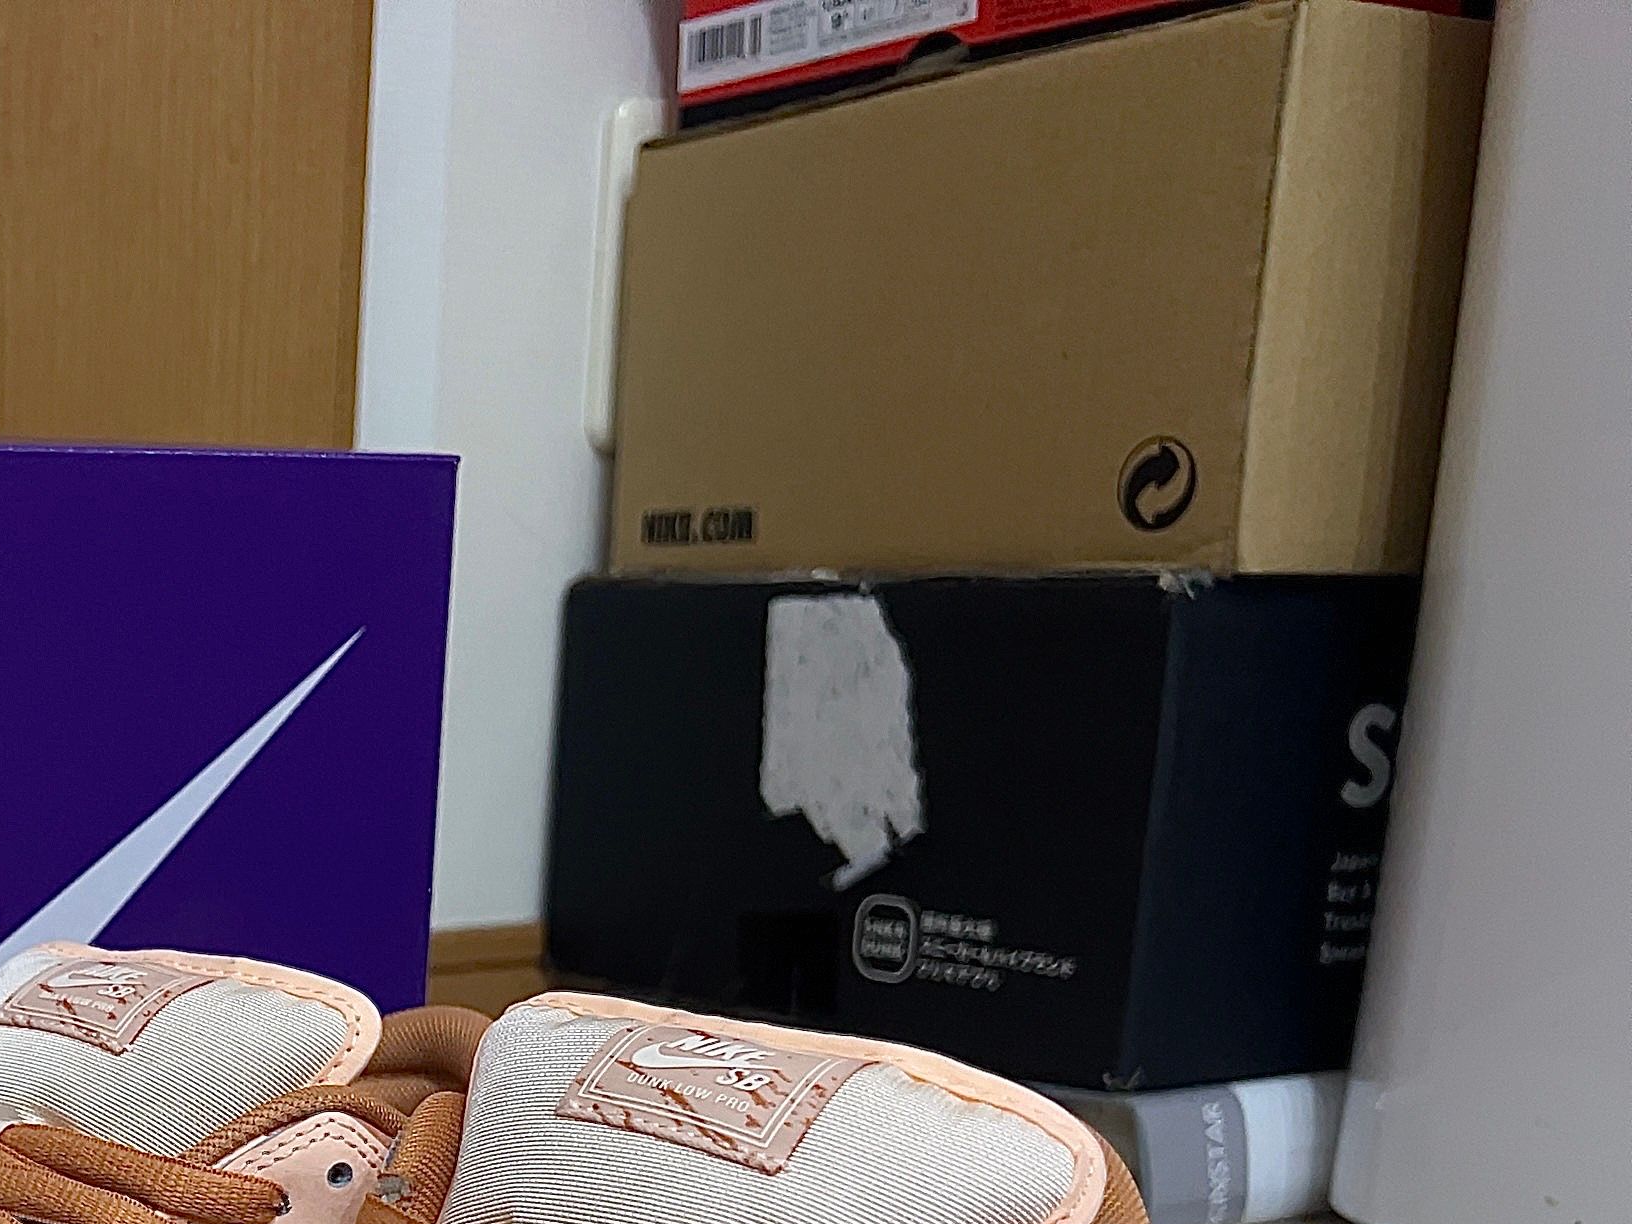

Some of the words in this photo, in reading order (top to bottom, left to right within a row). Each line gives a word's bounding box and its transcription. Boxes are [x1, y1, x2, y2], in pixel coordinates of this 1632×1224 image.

[668, 1033, 775, 1062] NIKE
[625, 1070, 672, 1090] DUNK
[674, 1081, 713, 1100] LOW
[715, 1092, 751, 1113] PRO
[717, 1067, 772, 1091] SB
